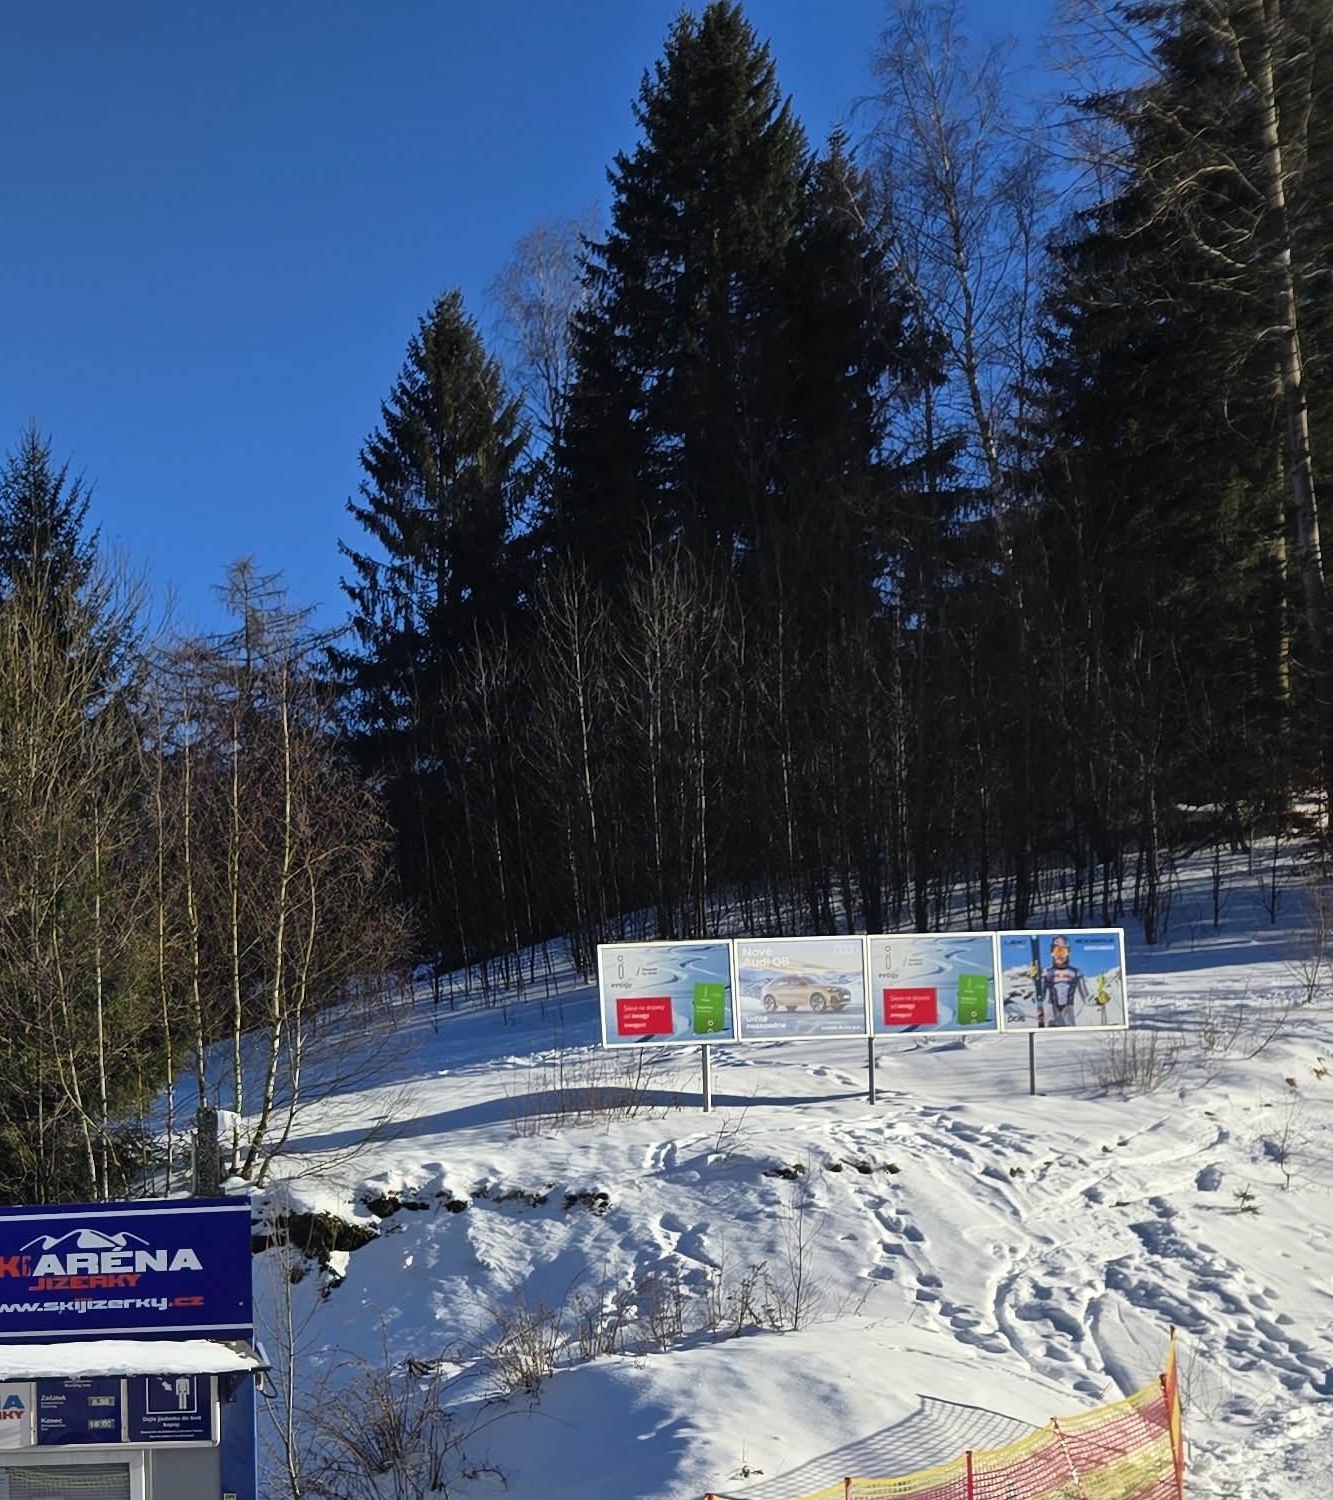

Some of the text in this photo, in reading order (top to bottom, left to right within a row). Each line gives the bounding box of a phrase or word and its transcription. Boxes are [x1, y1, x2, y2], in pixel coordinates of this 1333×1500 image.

[742, 946, 773, 956] Nové
[742, 956, 790, 967] Audi Q8
[28, 1274, 142, 1291] JIZERKY
